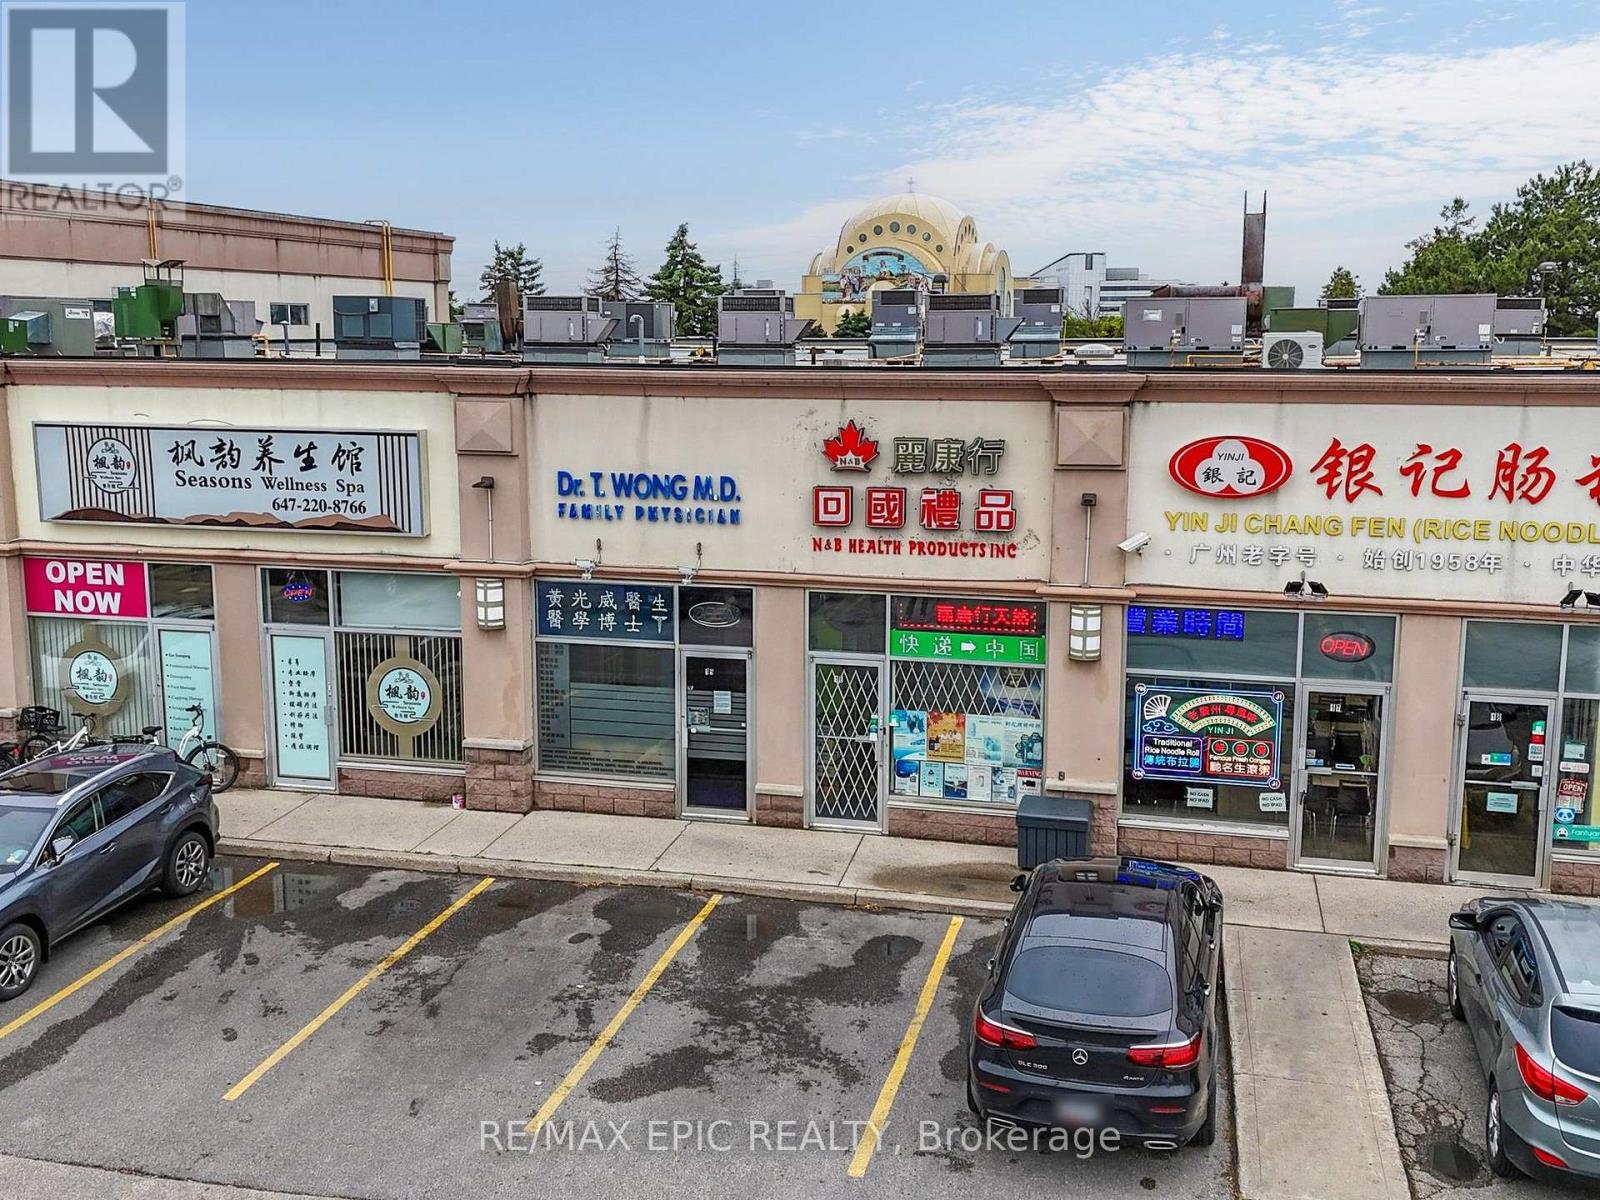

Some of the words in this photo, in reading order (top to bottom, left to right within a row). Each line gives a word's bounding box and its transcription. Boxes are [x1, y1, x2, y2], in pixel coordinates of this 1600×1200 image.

[168, 435, 365, 476] 枫韵养生馆
[838, 456, 861, 466] N&B
[892, 436, 1006, 476] 麗康行
[1217, 452, 1245, 462] YINJI
[175, 470, 252, 490] Seasons
[261, 476, 328, 492] Wellness
[336, 479, 365, 496] Spa
[556, 470, 586, 497] Dr.
[611, 472, 688, 500] WONG
[693, 474, 742, 502] M.D.
[1202, 466, 1257, 486] 銀記
[272, 497, 367, 514] 647-220-8766
[557, 503, 625, 522] FAMILY
[634, 505, 742, 526] PHYSICIAN
[812, 485, 1017, 532] 回國禮品
[1164, 511, 1209, 532] YIN
[1215, 512, 1238, 533] JI
[1244, 513, 1344, 537] CHANG
[1351, 516, 1407, 538] FEN
[1413, 518, 1491, 544] (RICE
[812, 537, 842, 552] N&B
[848, 538, 902, 556] HEALTH
[908, 540, 986, 558] PRODUCTS
[990, 543, 1018, 559] INC
[1189, 543, 1318, 568] 广州老字号
[1362, 546, 1503, 575] 始创1958年
[45, 560, 125, 586] OPEN
[54, 589, 121, 615] NOW
[546, 609, 643, 633] 醫學博士
[899, 634, 953, 656] 快递
[985, 638, 1039, 661] 中国
[1320, 637, 1369, 657] OPEN
[1144, 746, 1160, 754] Rice
[1160, 747, 1185, 756] Noodle
[1186, 749, 1200, 757] Roll
[1153, 738, 1193, 748] Traditional
[1563, 783, 1583, 792] OPEN
